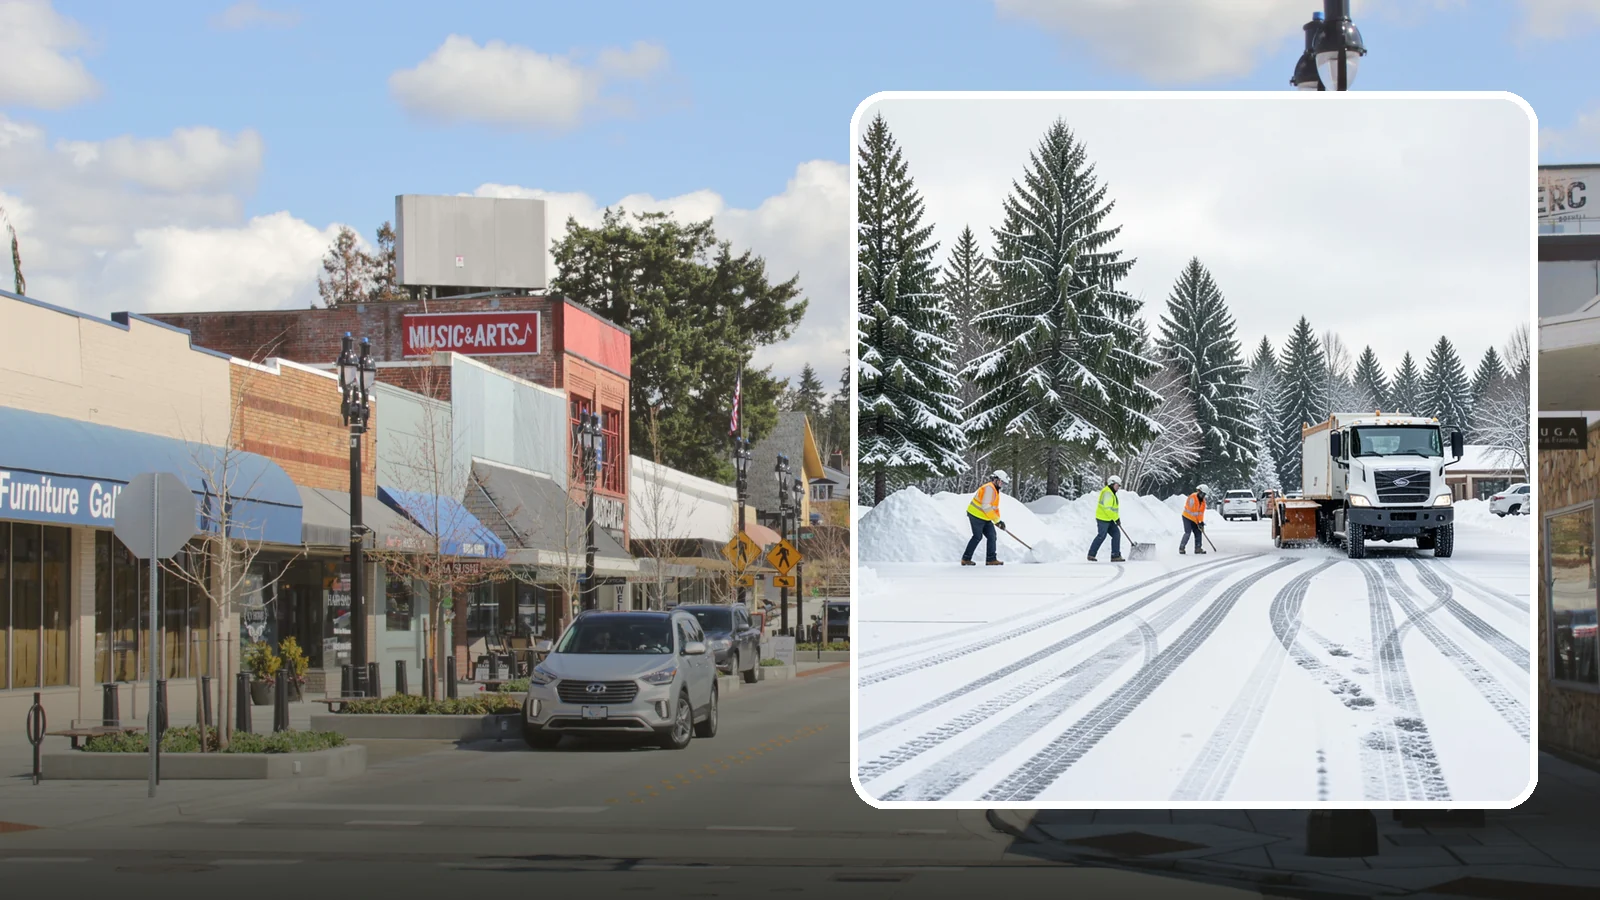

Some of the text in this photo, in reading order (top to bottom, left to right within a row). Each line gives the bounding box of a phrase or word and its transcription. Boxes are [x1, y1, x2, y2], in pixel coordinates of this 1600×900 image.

[409, 323, 519, 349] MUSIC&ARTS
[1540, 427, 1577, 436] UGA
[0, 471, 79, 515] Furniture
